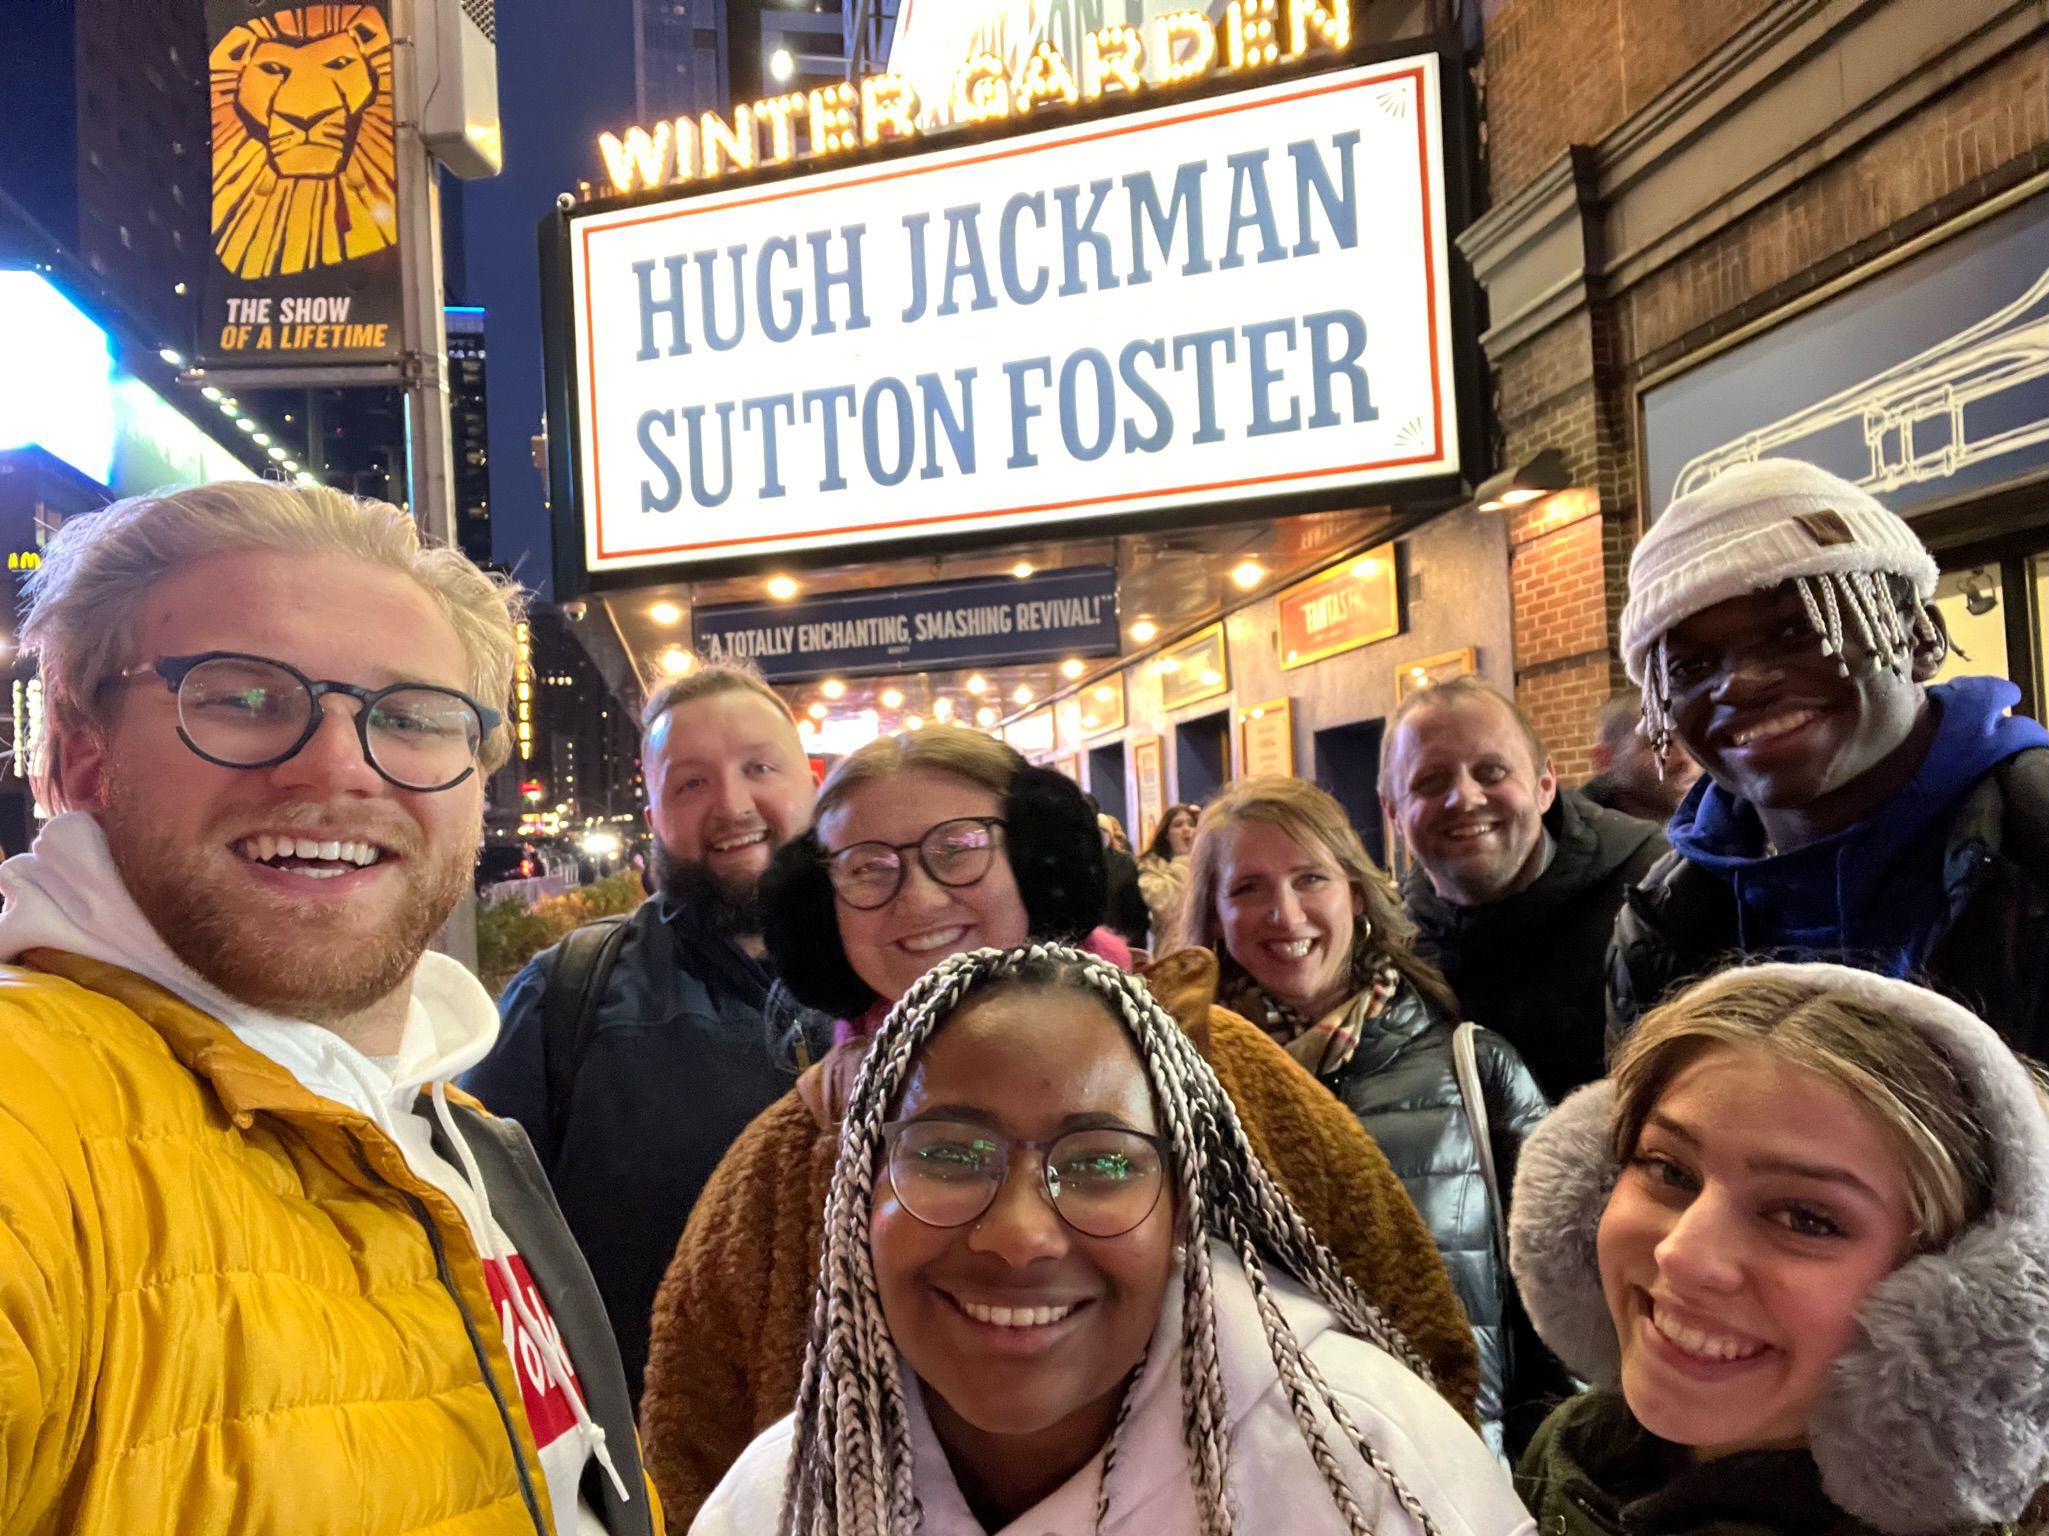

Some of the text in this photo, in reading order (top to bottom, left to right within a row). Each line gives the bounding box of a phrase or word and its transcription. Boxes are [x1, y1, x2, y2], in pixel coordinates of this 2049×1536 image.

[597, 0, 1351, 193] WINTER GARDEN
[631, 129, 1361, 362] HUGH JACKMAN
[220, 324, 389, 350] OF A LIFETIME
[226, 297, 351, 324] THE SHOW
[637, 308, 1380, 514] SUTTON FOSTER
[725, 625, 795, 658] TOTALLY
[798, 615, 912, 652] ENCHANTING,
[914, 603, 1012, 642] SMASHING
